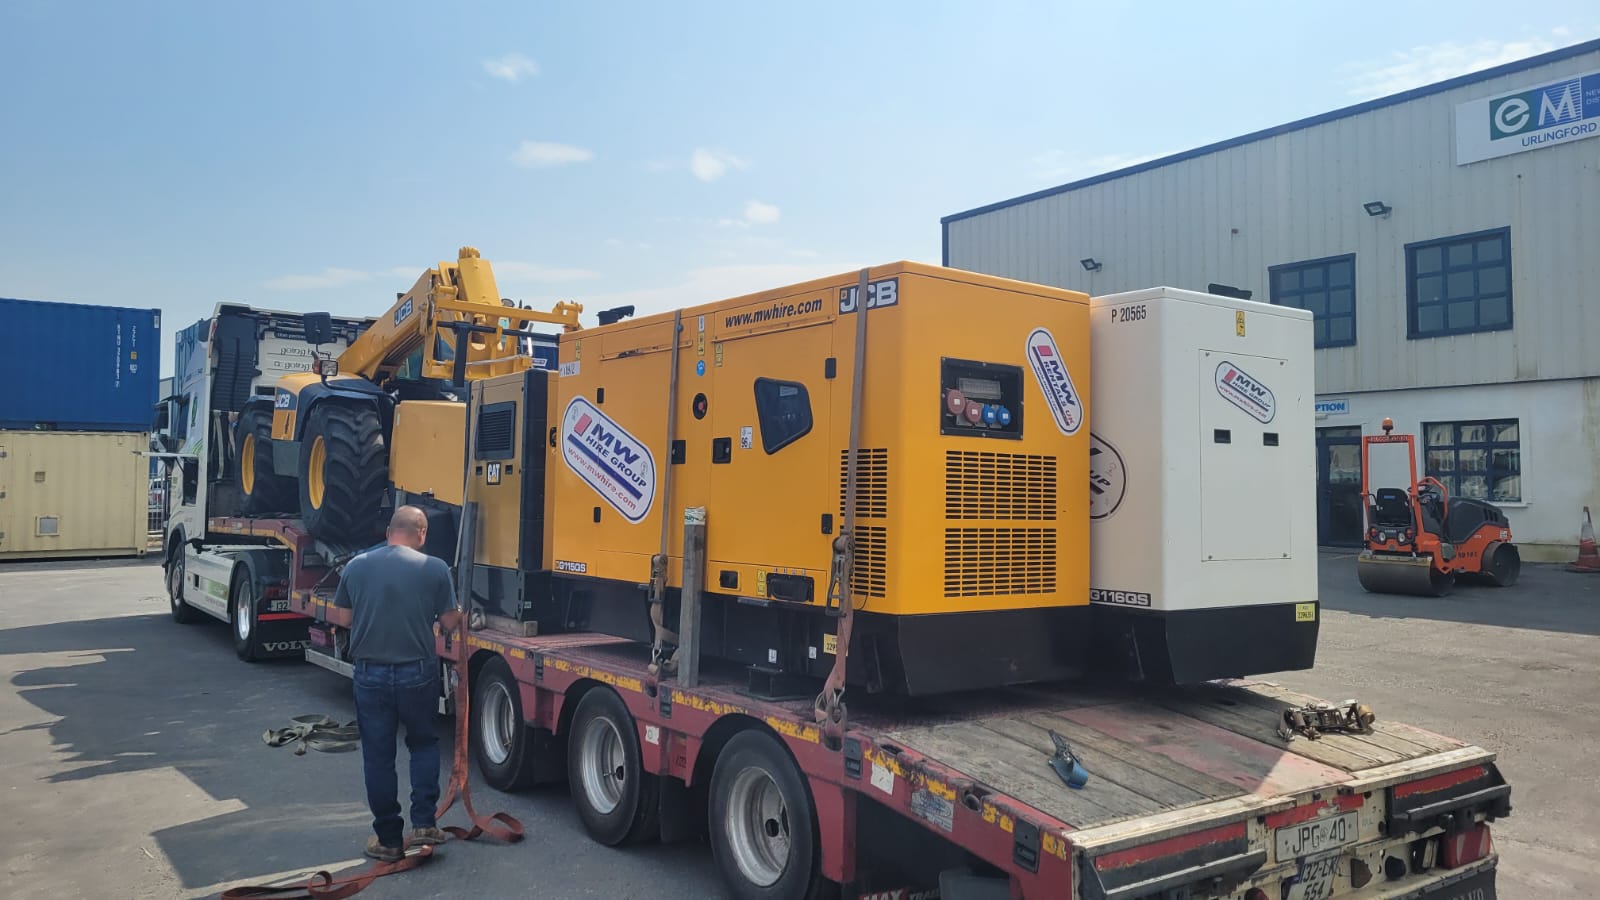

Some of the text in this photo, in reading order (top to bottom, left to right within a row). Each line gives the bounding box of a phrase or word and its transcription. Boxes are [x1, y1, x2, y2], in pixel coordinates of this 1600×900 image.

[1521, 122, 1597, 146] URLINGFORD
[395, 299, 412, 325] JCB
[725, 299, 822, 328] www.mwhire.com
[1111, 305, 1147, 323] P 20565
[1044, 361, 1067, 407] RENTALS
[1050, 360, 1076, 406] MW
[1236, 375, 1266, 397] MW
[275, 393, 290, 408] JCB
[591, 423, 640, 465] MW
[487, 463, 501, 483] CAT
[585, 435, 647, 488] HIRE GROUP
[568, 447, 637, 510] www.mwhire.com
[1292, 817, 1346, 854] JPG 40
[1303, 880, 1325, 900] 554
